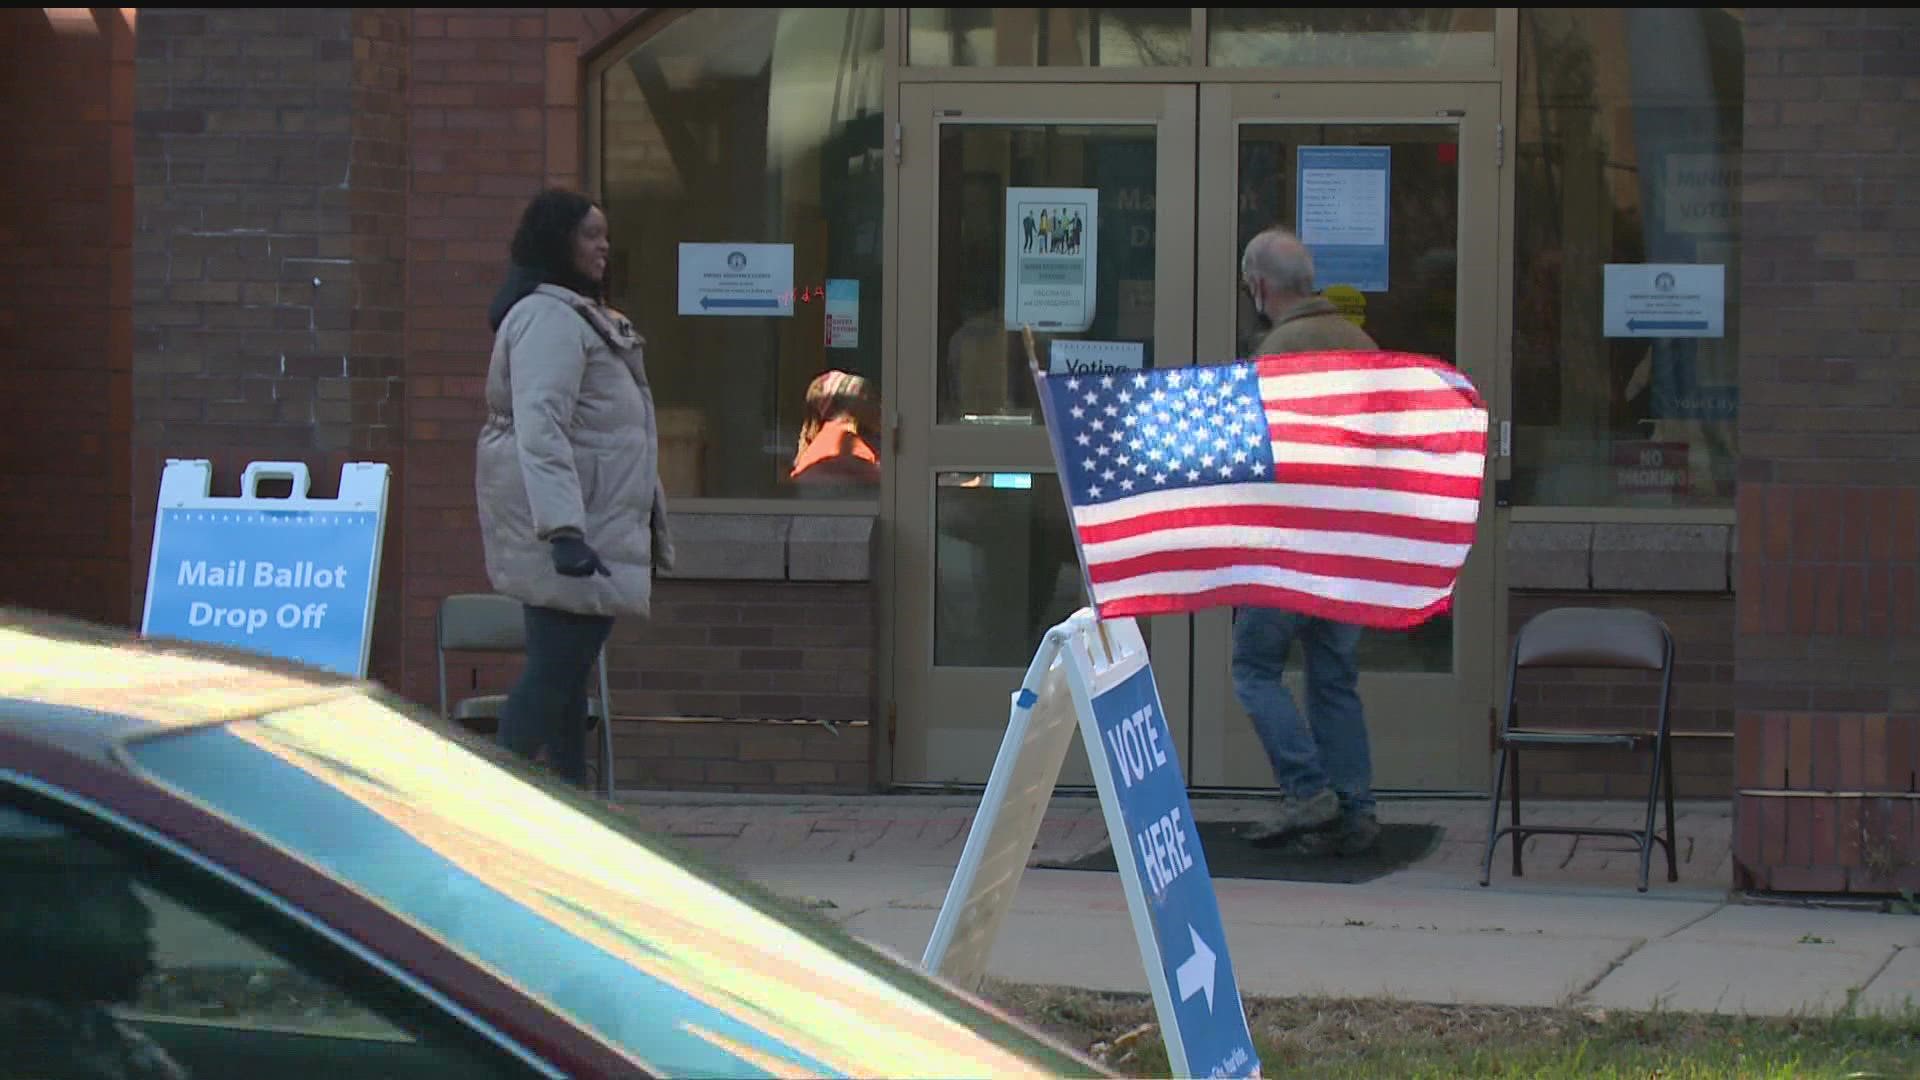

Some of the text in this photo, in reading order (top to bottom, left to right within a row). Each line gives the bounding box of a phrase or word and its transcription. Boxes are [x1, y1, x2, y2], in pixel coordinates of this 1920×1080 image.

[1640, 449, 1663, 466] NO
[177, 559, 347, 588] Mail Ballot
[188, 601, 327, 635] Drop Off
[1108, 704, 1167, 788] VOTE
[1138, 807, 1193, 896] HERE
